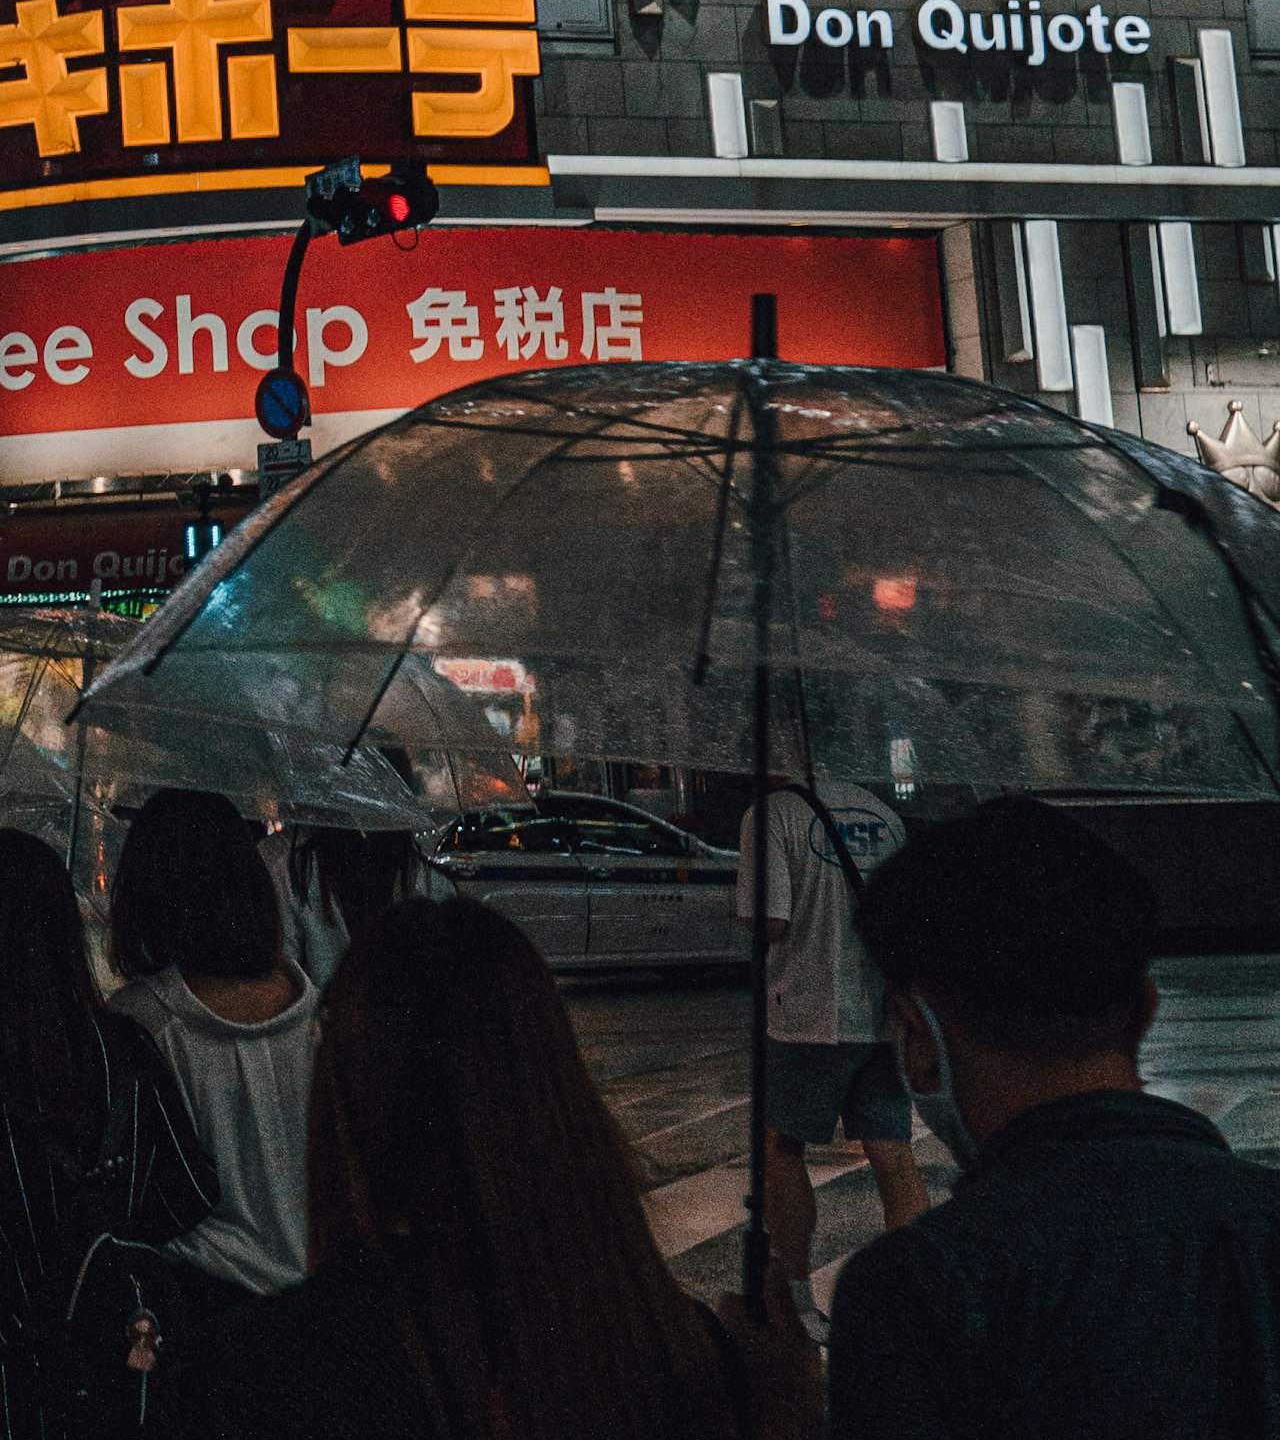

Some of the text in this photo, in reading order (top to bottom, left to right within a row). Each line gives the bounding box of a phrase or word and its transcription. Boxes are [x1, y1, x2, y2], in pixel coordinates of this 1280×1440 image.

[122, 294, 368, 387] Shop
[407, 285, 645, 365] 免税店
[6, 553, 78, 584] Don
